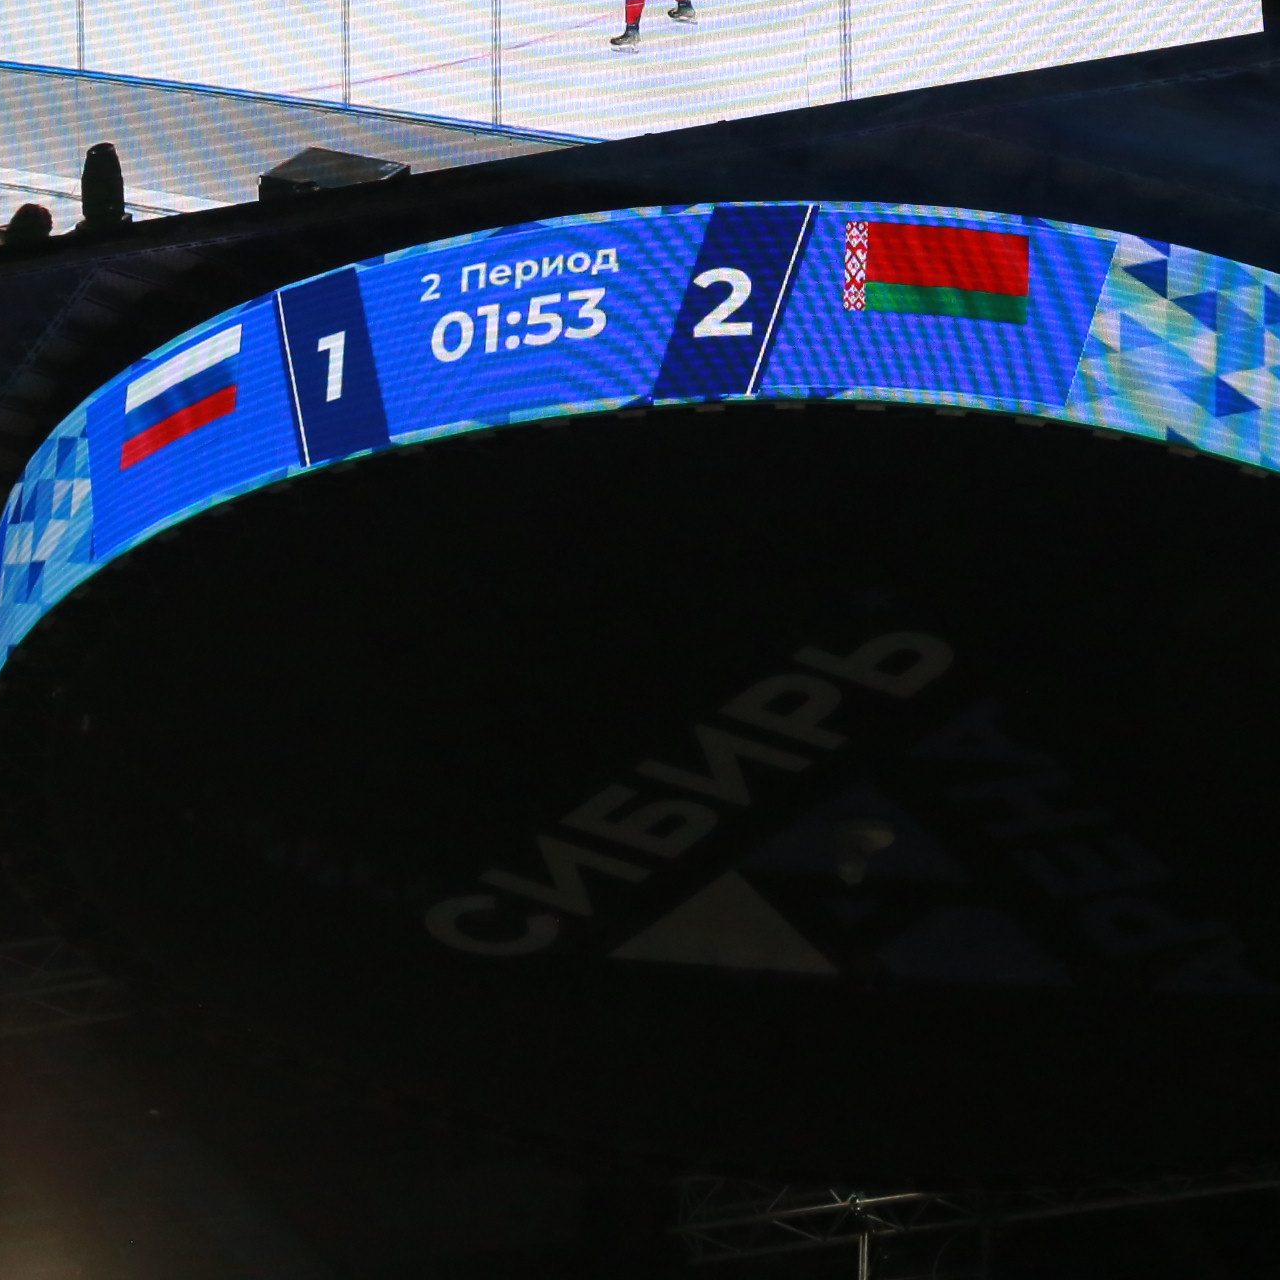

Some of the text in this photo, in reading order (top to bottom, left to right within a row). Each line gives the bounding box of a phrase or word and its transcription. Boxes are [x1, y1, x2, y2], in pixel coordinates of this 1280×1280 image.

[420, 248, 620, 303] 2 Период
[692, 267, 754, 339] 2
[430, 287, 608, 363] 01:53
[316, 331, 347, 402] 1
[423, 631, 955, 958] СИБИРЬ
